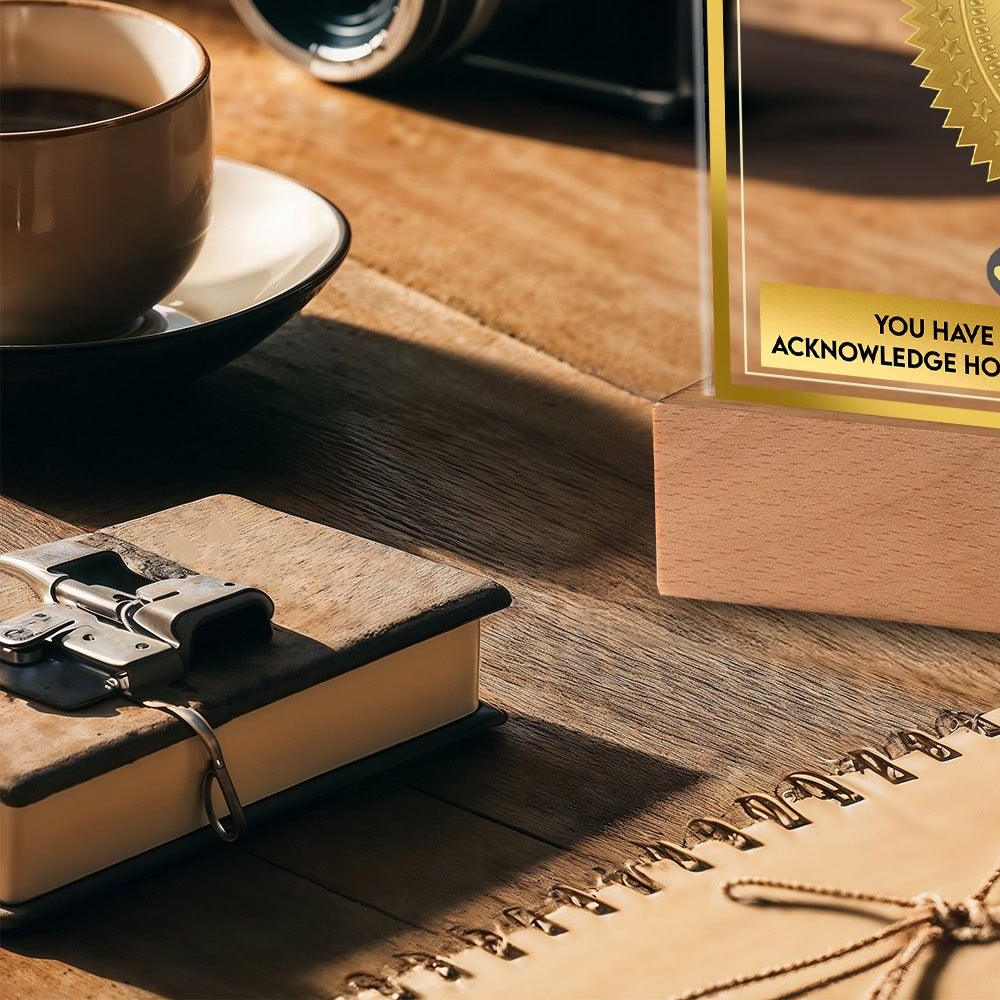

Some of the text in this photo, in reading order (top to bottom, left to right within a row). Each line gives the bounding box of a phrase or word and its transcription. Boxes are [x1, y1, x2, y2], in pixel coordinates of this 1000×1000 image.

[874, 313, 925, 338] YOU
[933, 320, 994, 346] HAVE
[771, 334, 956, 373] ACKNOWLEDGE
